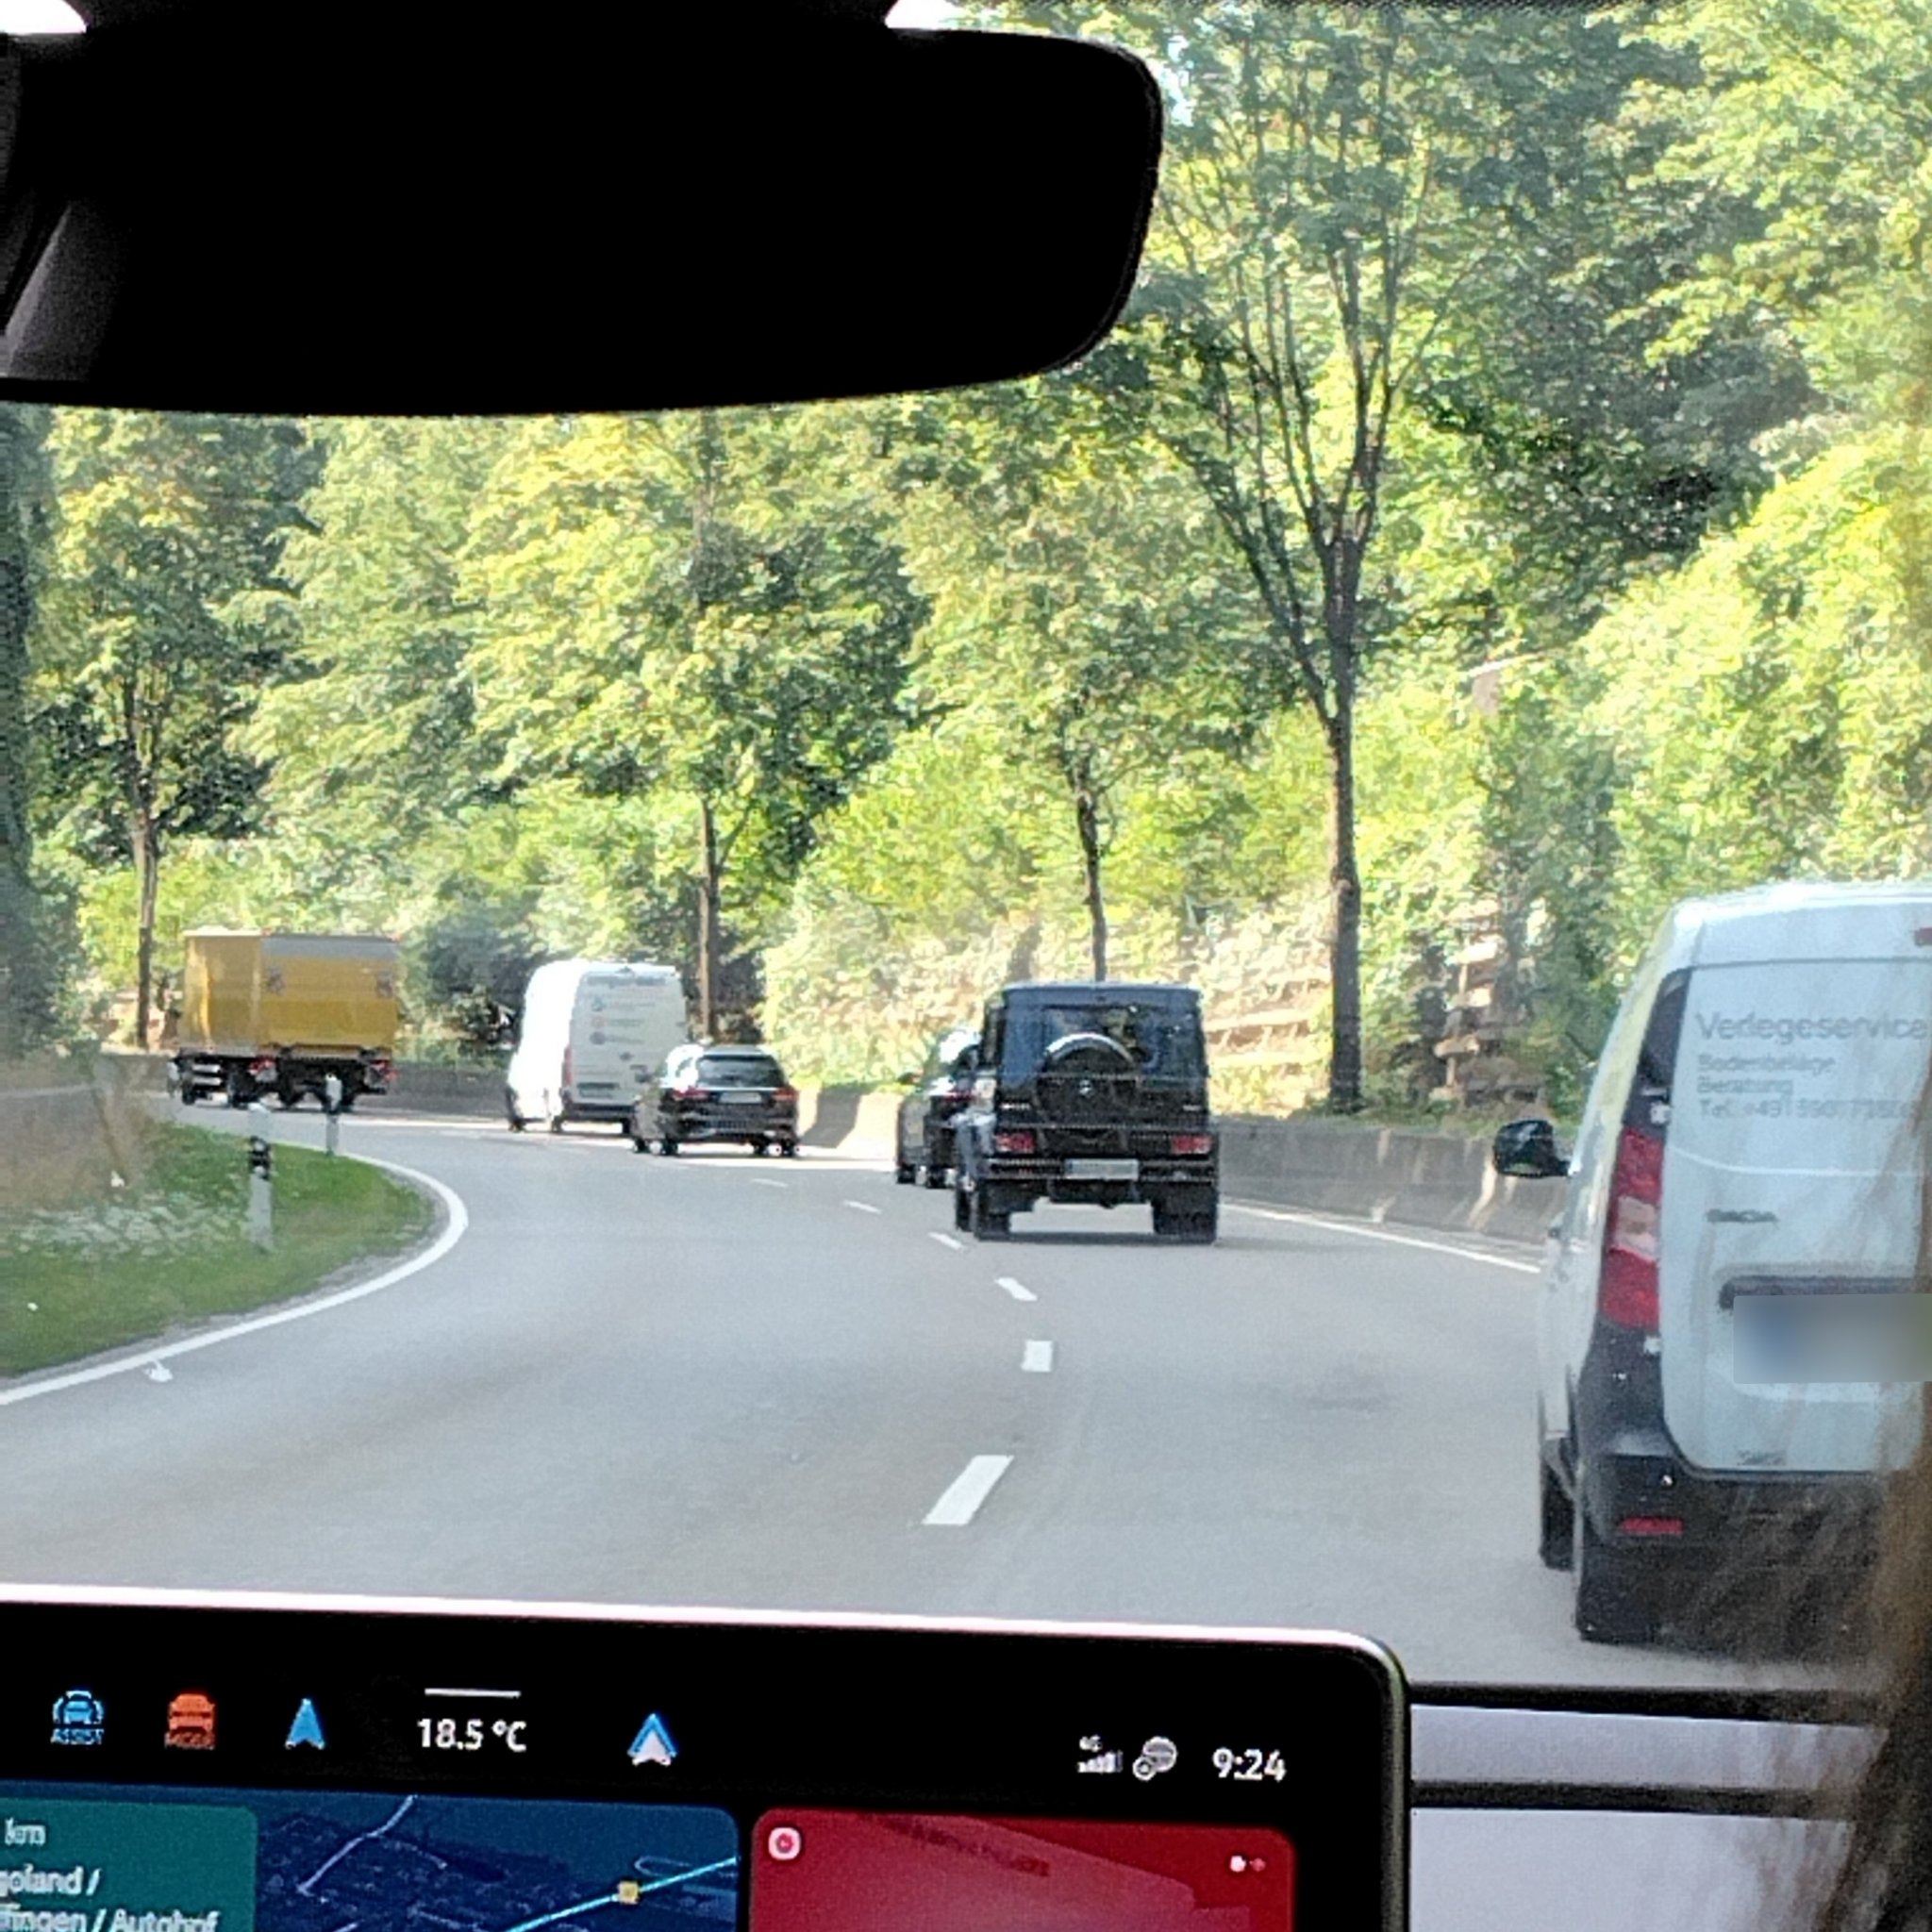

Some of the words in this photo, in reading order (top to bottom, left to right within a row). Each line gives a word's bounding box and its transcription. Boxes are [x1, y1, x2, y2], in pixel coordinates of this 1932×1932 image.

[417, 1718, 484, 1750] 18.5
[1212, 1747, 1287, 1782] 9:24
[5, 1817, 46, 1845] km
